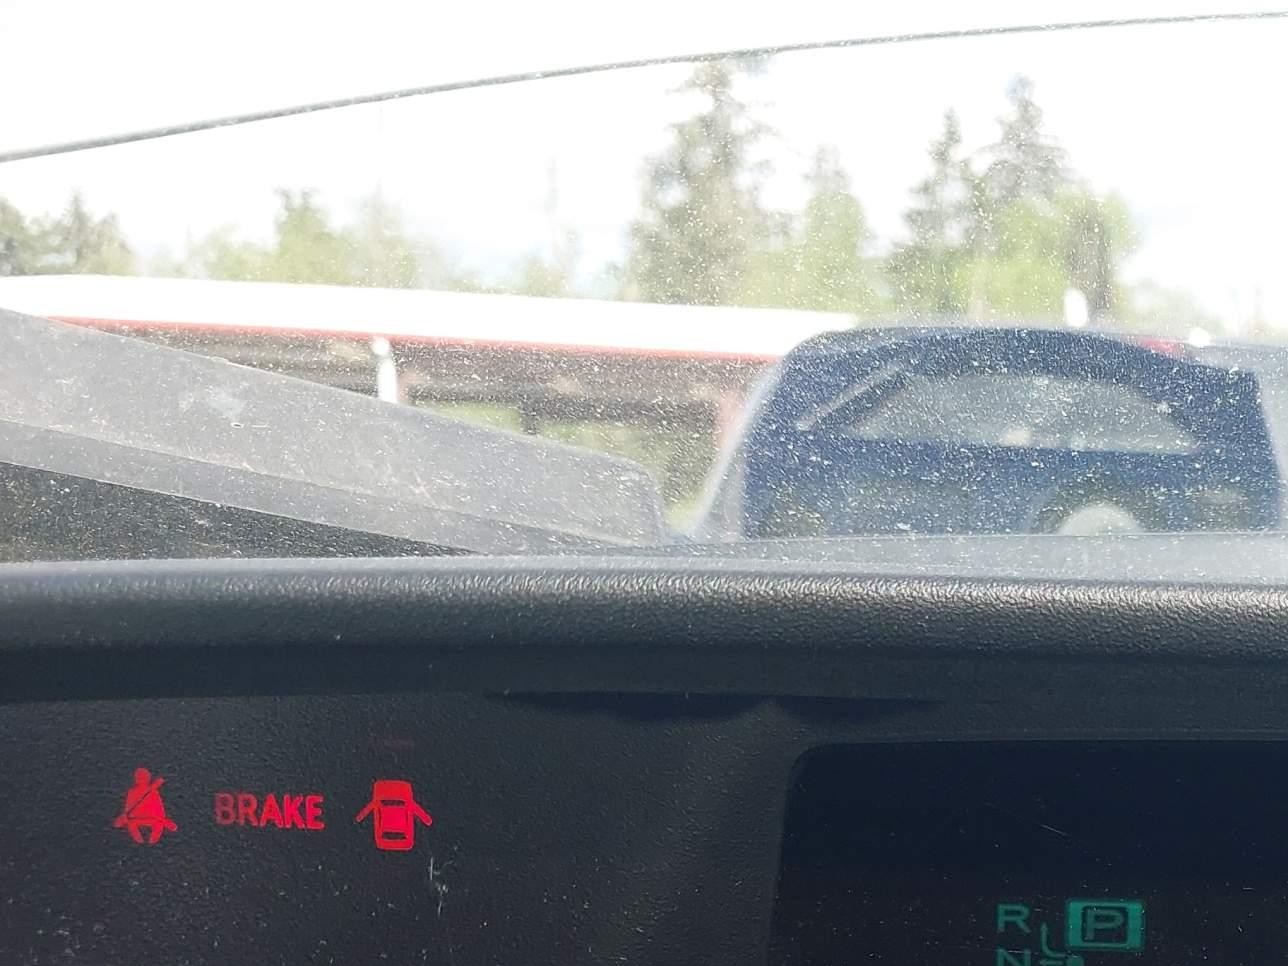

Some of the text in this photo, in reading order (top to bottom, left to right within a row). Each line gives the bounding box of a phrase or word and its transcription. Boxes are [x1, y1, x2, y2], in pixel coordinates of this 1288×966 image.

[214, 792, 326, 830] BRAKE
[997, 903, 1031, 934] R
[1085, 908, 1124, 941] P
